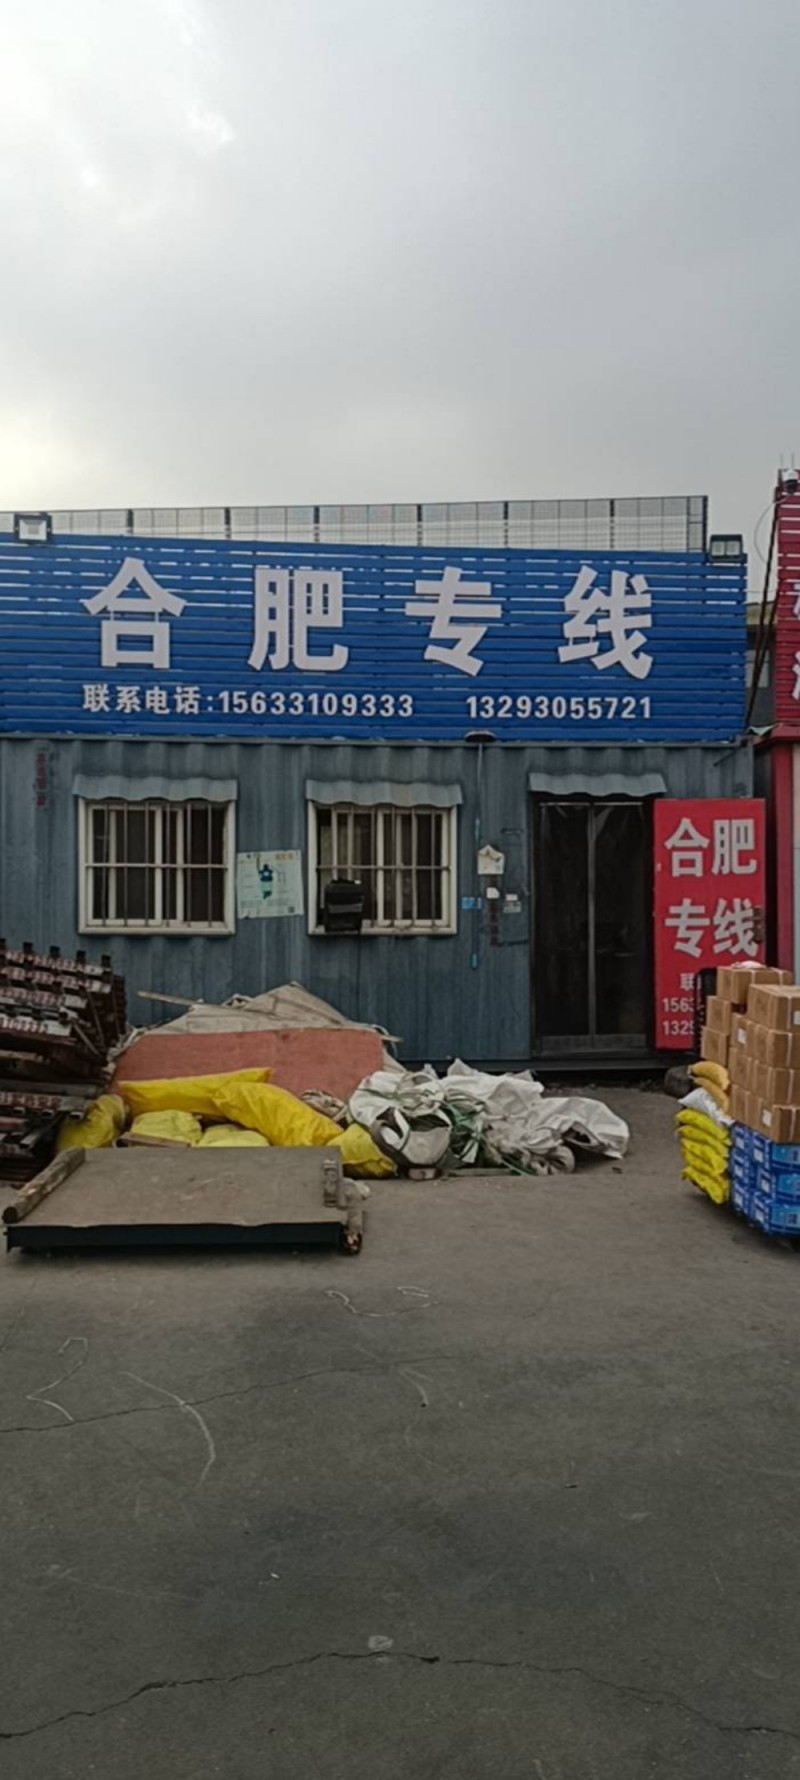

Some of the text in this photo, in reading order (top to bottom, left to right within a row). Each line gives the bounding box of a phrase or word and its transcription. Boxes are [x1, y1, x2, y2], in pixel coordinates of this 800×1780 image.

[79, 556, 654, 680] 合肥专线
[466, 695, 652, 719] 13293055721
[664, 817, 757, 877] 合肥
[664, 898, 759, 958] 专线
